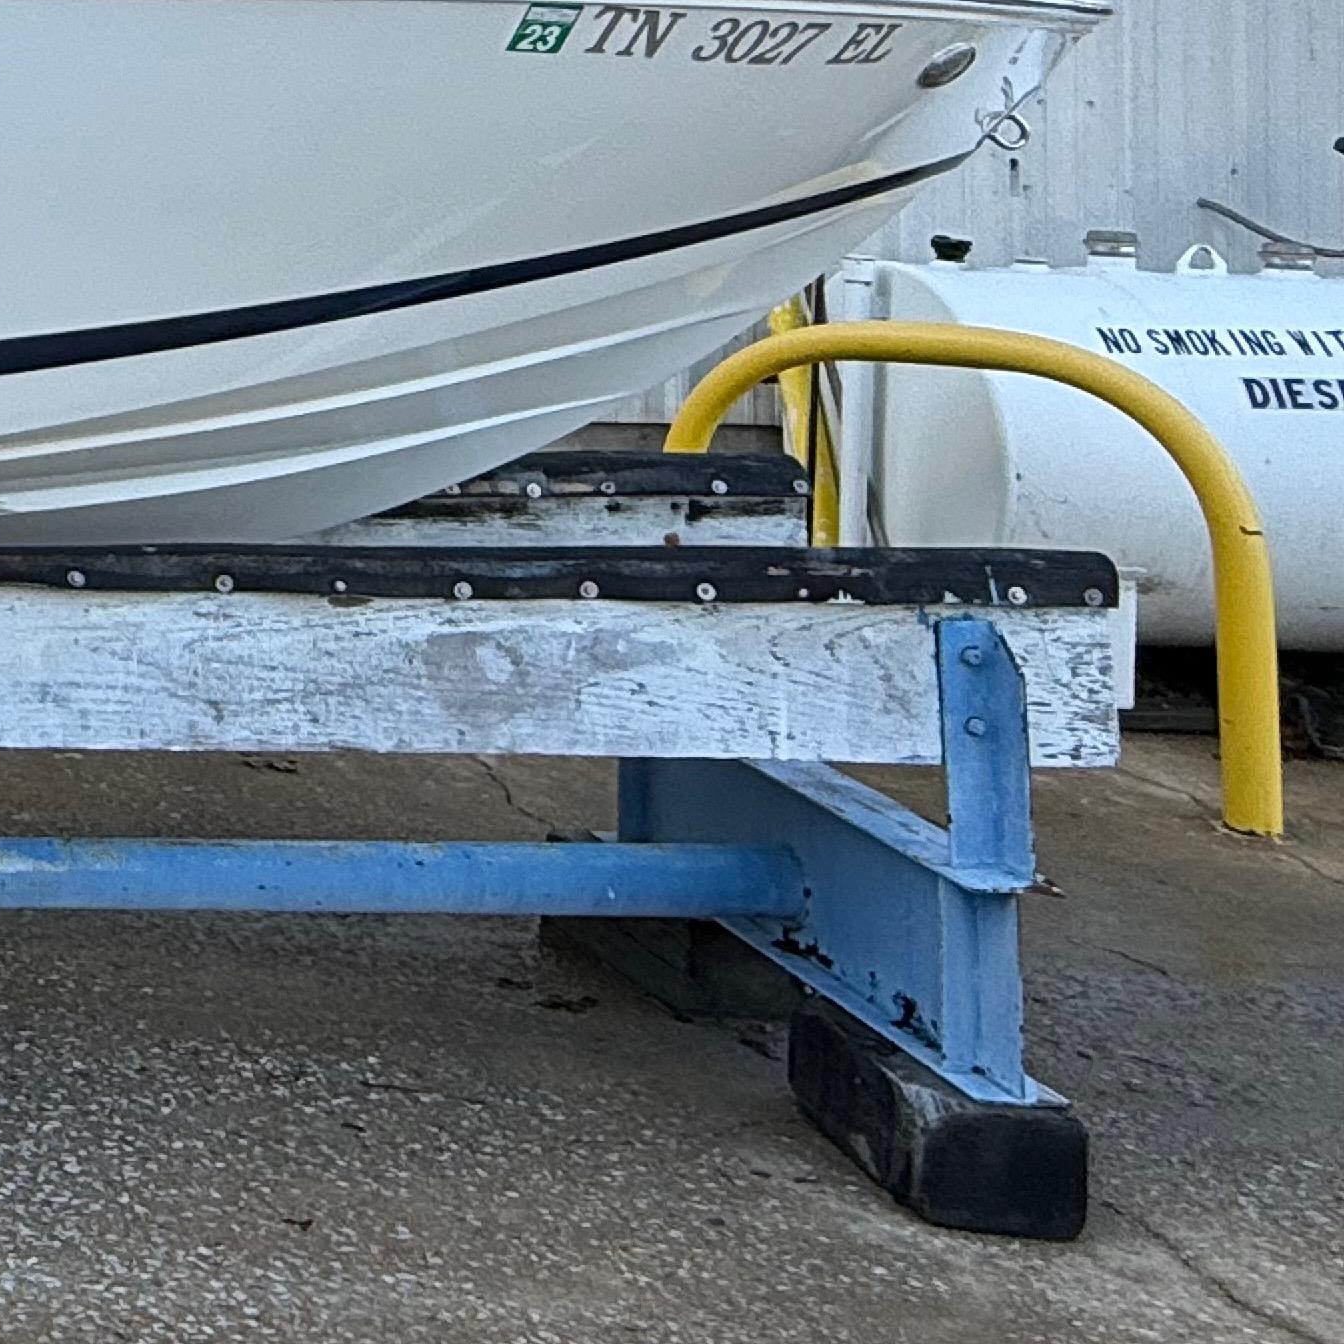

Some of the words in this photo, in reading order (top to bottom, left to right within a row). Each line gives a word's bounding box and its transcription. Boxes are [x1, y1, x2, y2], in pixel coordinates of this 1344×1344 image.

[515, 24, 562, 52] 23
[584, 4, 687, 58] TN
[691, 17, 832, 65] 3027
[826, 22, 903, 65] EL
[1095, 326, 1142, 354] NO
[1146, 328, 1287, 356] SMOKING
